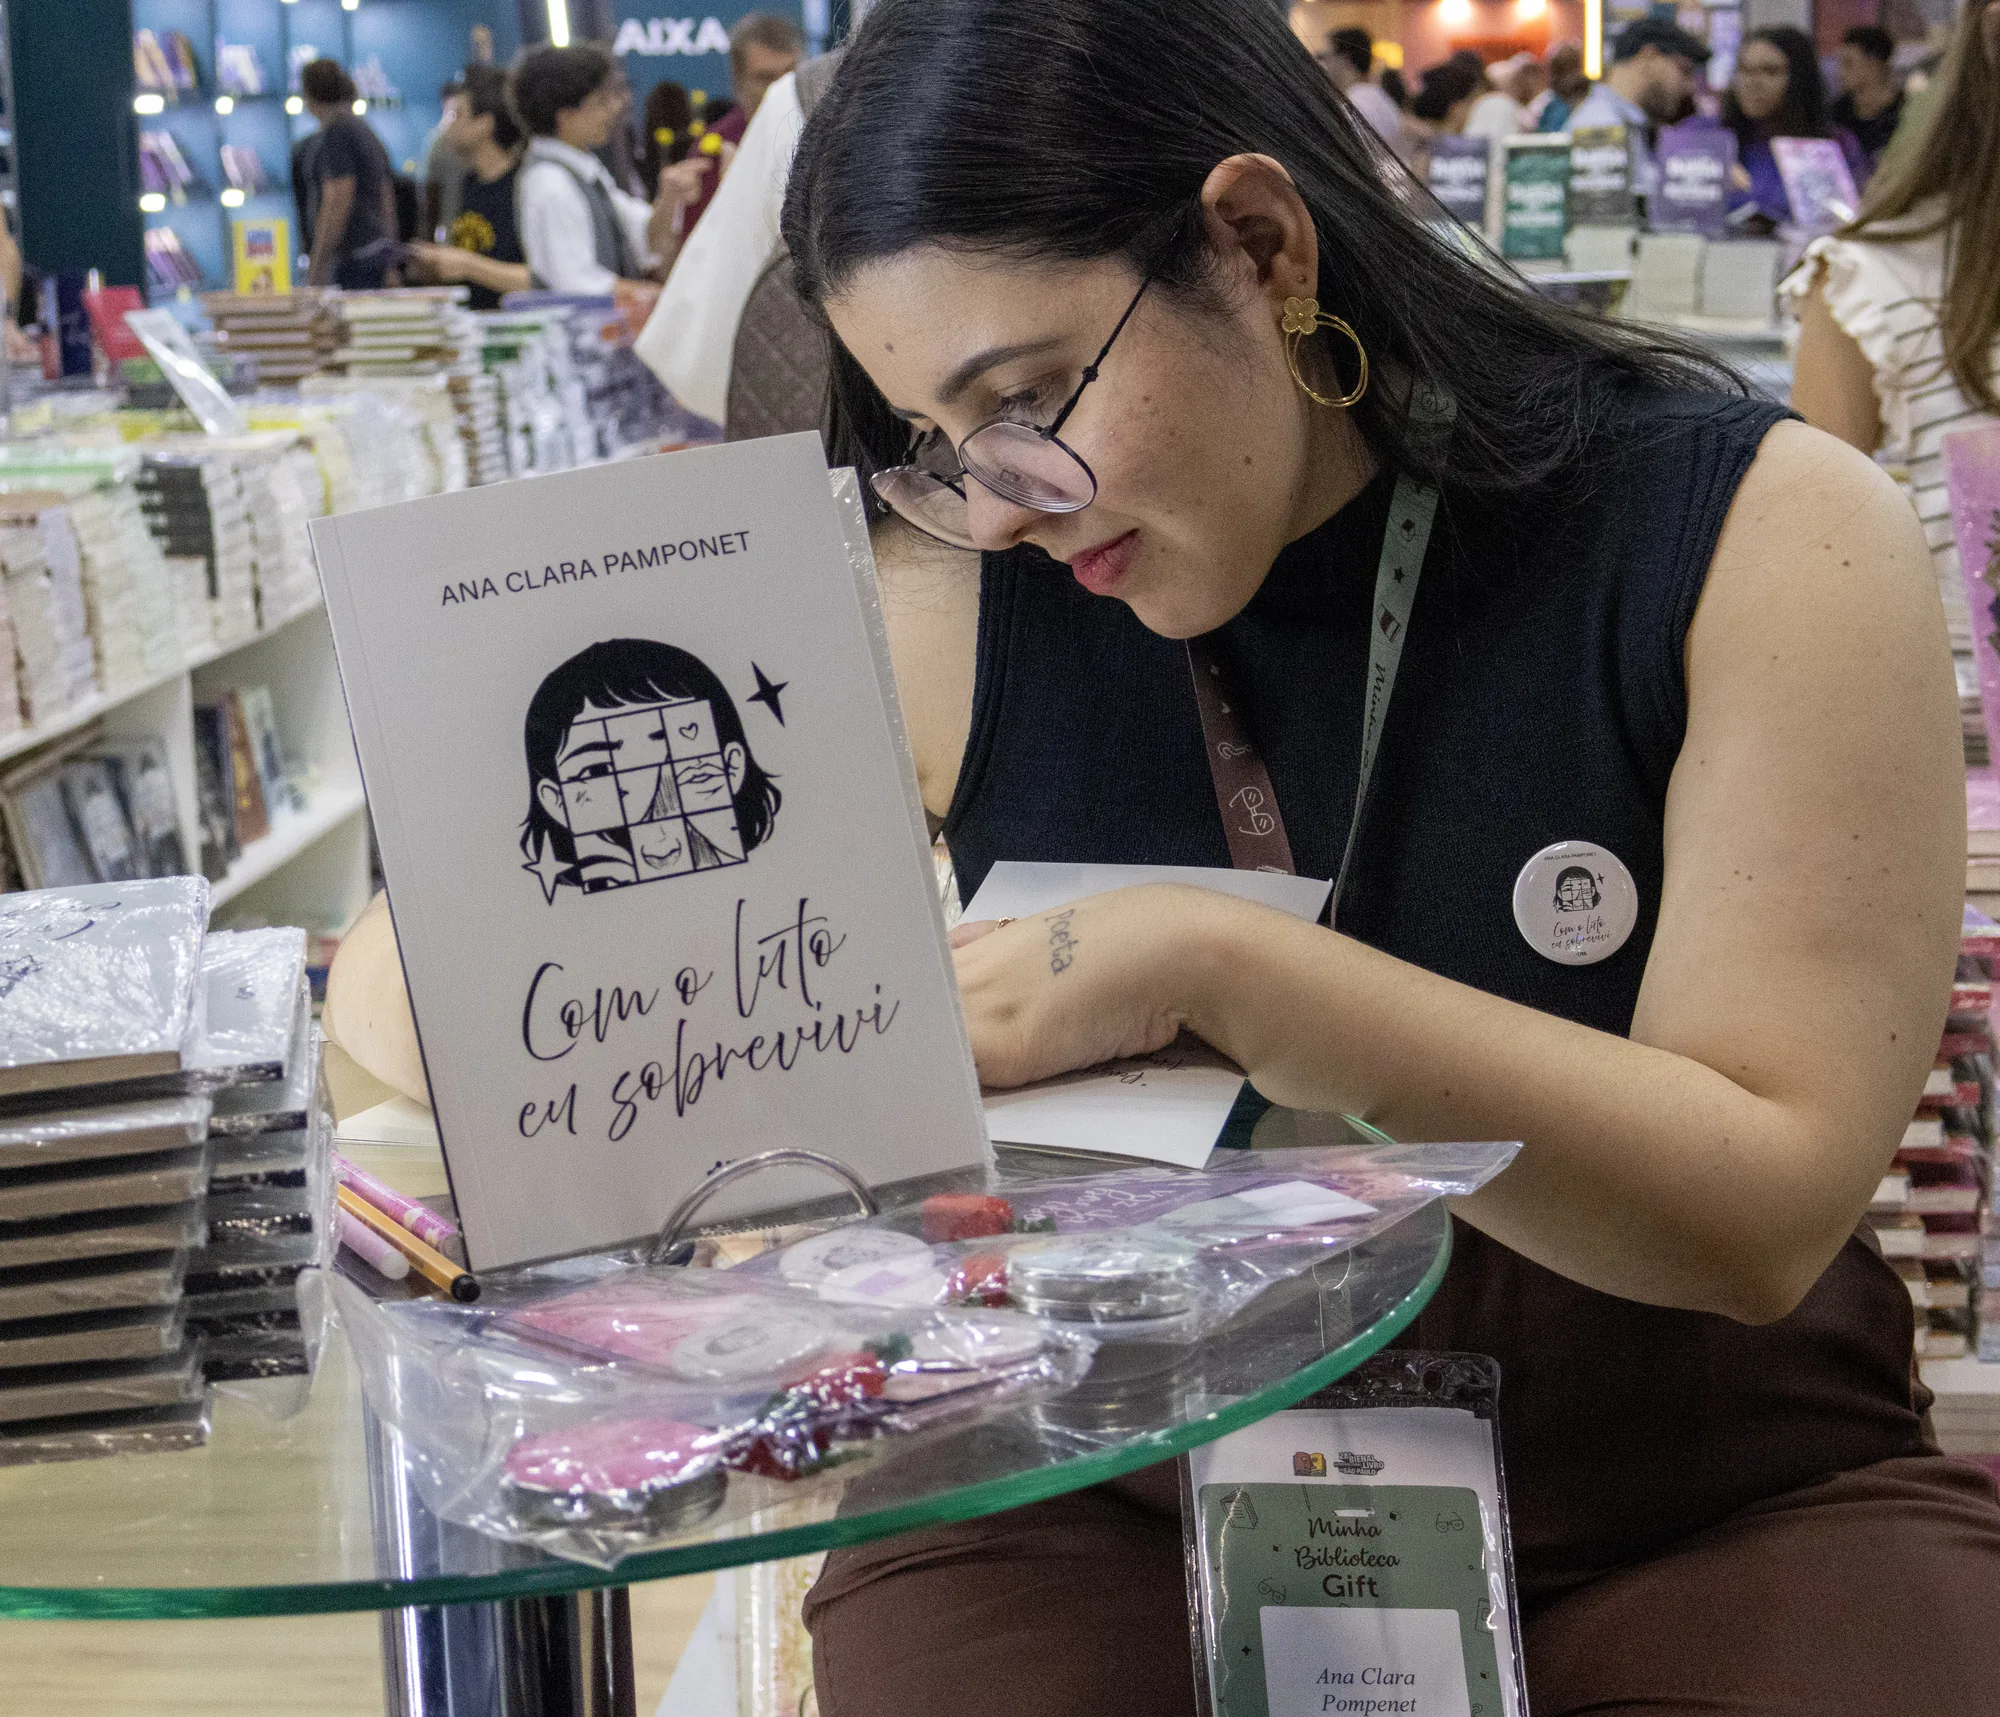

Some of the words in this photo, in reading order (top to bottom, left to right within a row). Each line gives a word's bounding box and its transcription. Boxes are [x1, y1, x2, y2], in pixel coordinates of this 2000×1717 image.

[441, 577, 499, 606] ANA
[505, 559, 597, 592] CLARA
[603, 530, 750, 575] PAMPONET
[1367, 662, 1386, 742] Minha
[1553, 922, 1574, 937] Com
[1586, 915, 1605, 934] luto
[522, 962, 659, 1060] Com
[676, 966, 713, 1005] o
[736, 898, 846, 1017] luto
[518, 1083, 578, 1138] eu
[608, 983, 900, 1141] sobrevivi
[1349, 1454, 1375, 1463] BIENAL
[1362, 1461, 1384, 1469] LIVRO
[1308, 1517, 1382, 1539] Minha
[1294, 1546, 1401, 1570] Biblioteca
[1322, 1574, 1379, 1597] Gift
[1316, 1667, 1354, 1685] Ana
[1361, 1667, 1415, 1685] Clara
[1322, 1694, 1417, 1717] Pompenet
